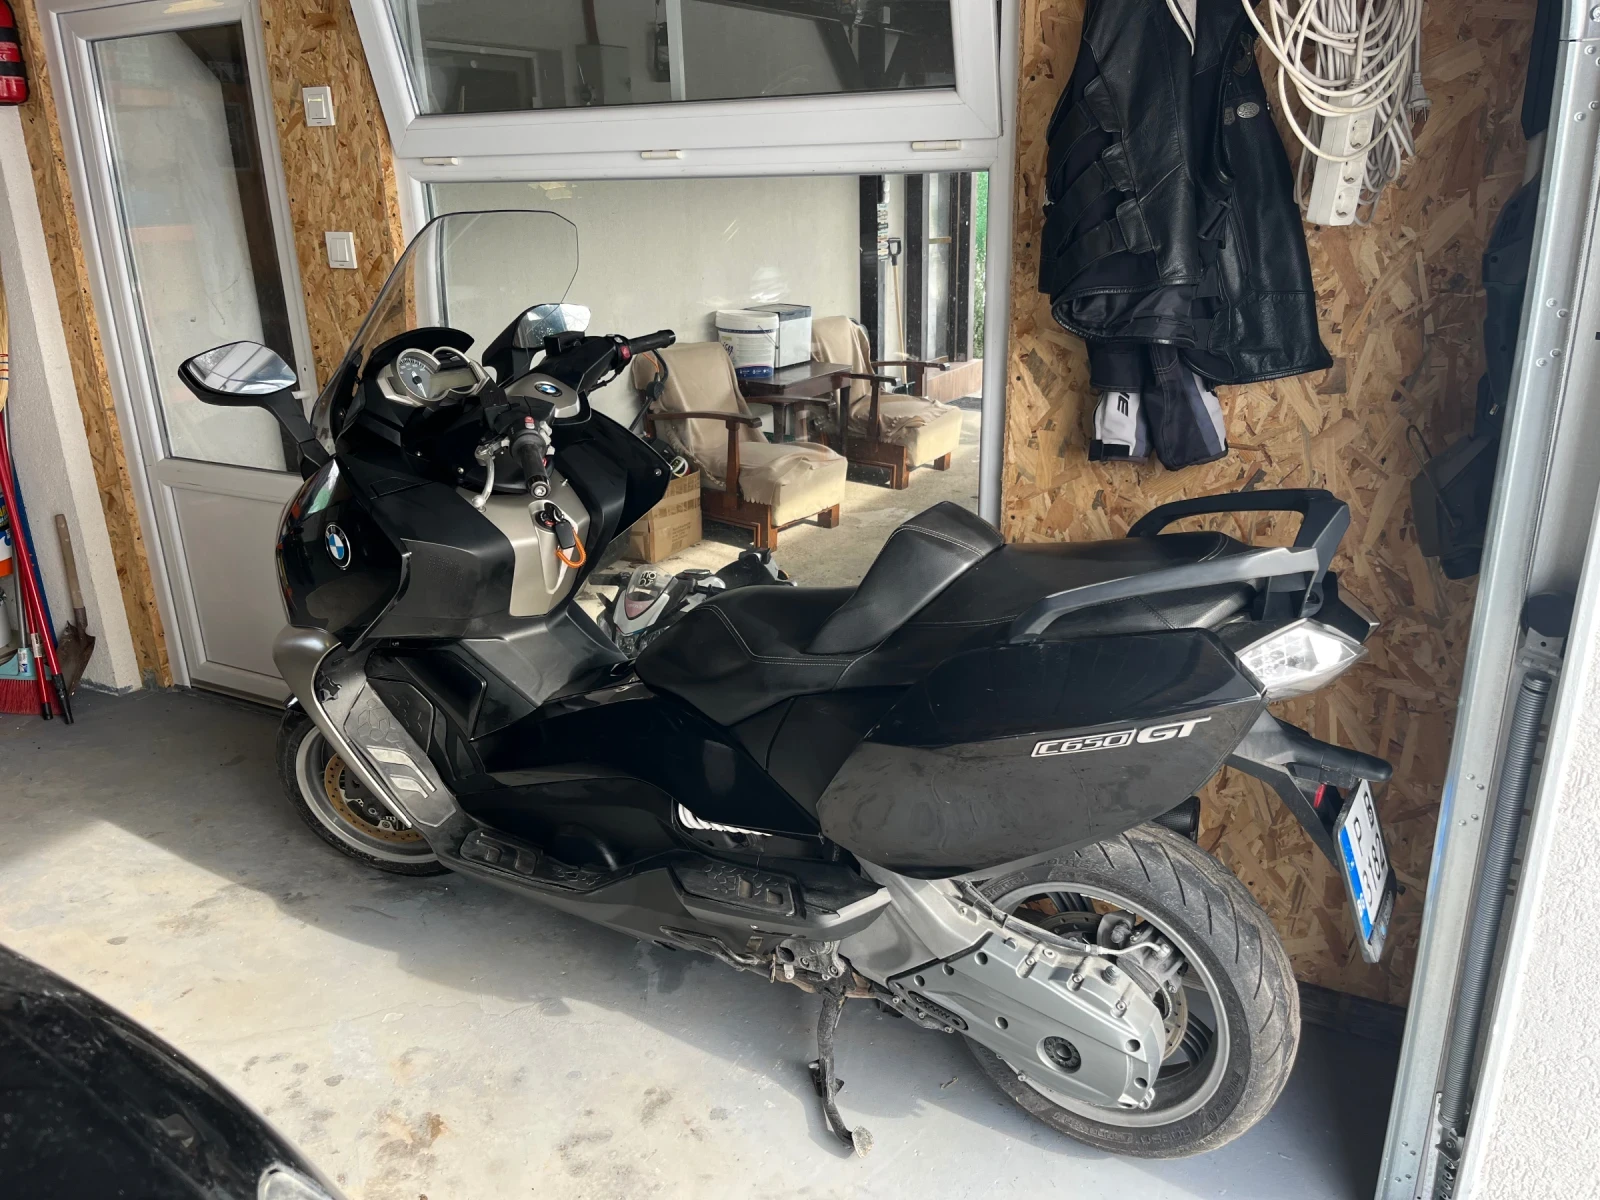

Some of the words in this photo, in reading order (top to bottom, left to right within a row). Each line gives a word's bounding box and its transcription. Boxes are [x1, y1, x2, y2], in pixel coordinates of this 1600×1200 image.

[1037, 733, 1129, 754] C650
[1137, 716, 1211, 744] GT
[1362, 832, 1386, 908] 3182
